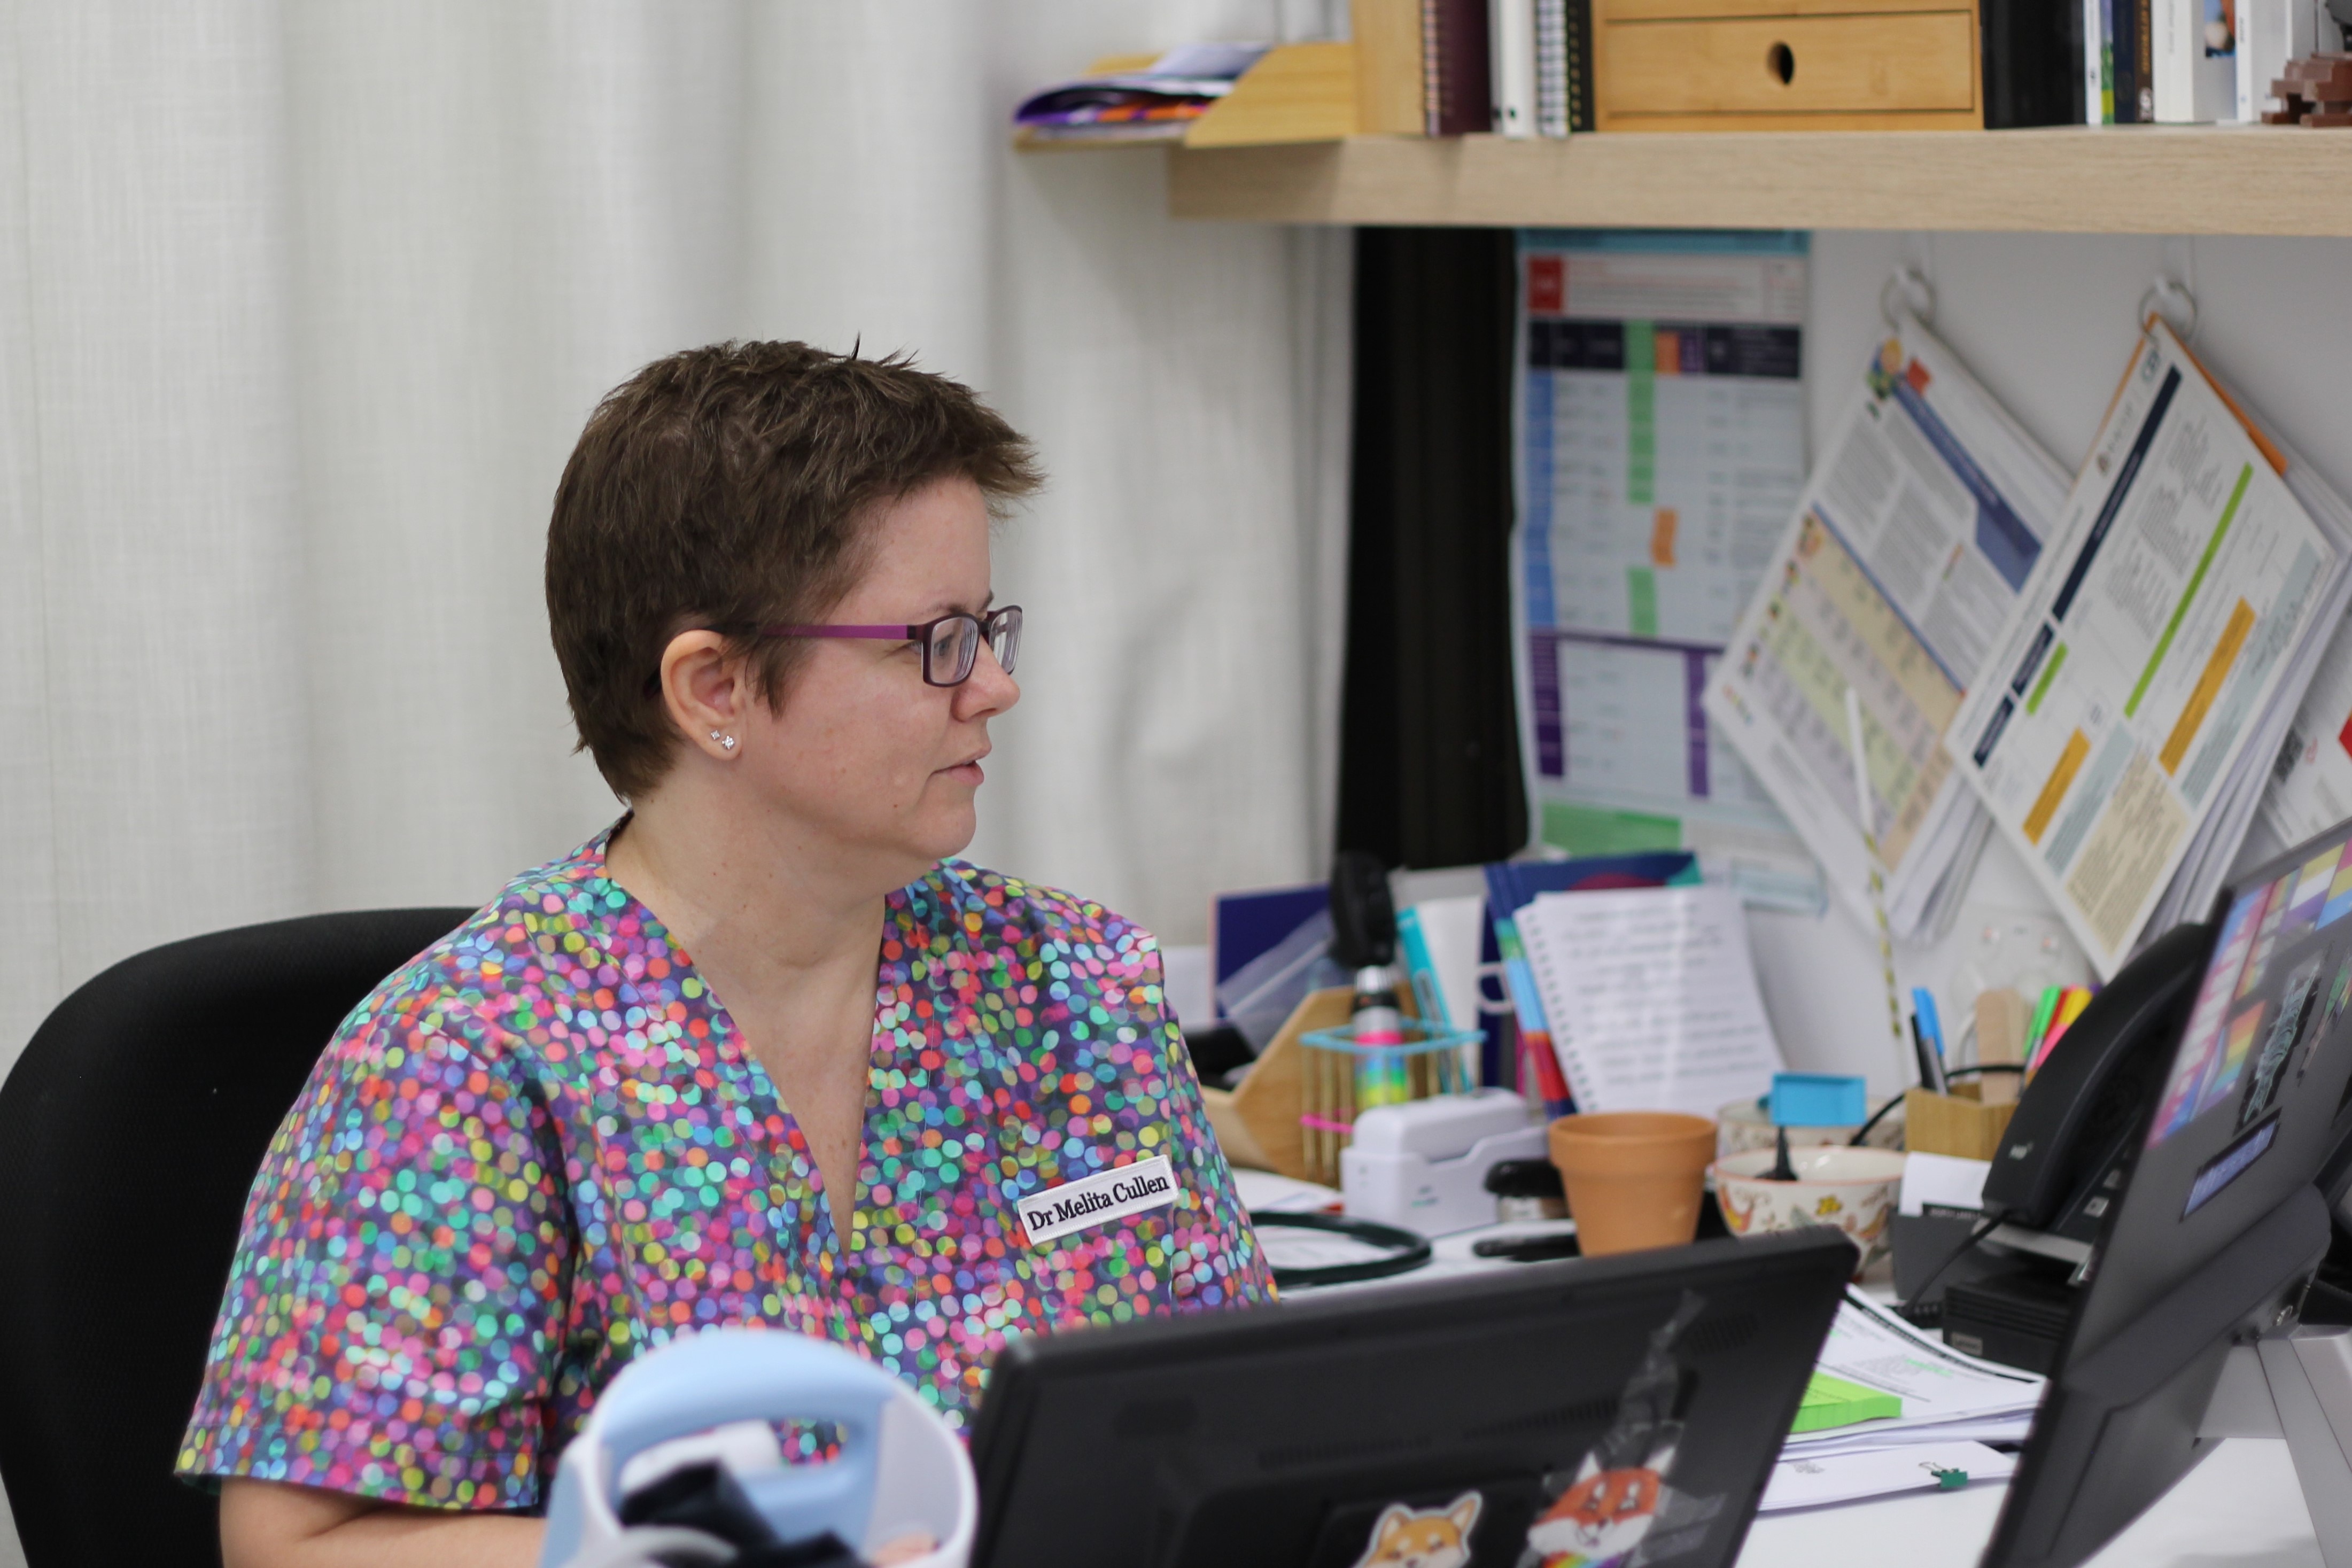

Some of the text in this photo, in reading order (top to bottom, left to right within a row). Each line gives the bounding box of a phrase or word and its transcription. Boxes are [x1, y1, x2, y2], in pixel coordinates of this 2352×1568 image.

[1027, 1175, 1170, 1231] Dr Melita Cullen
